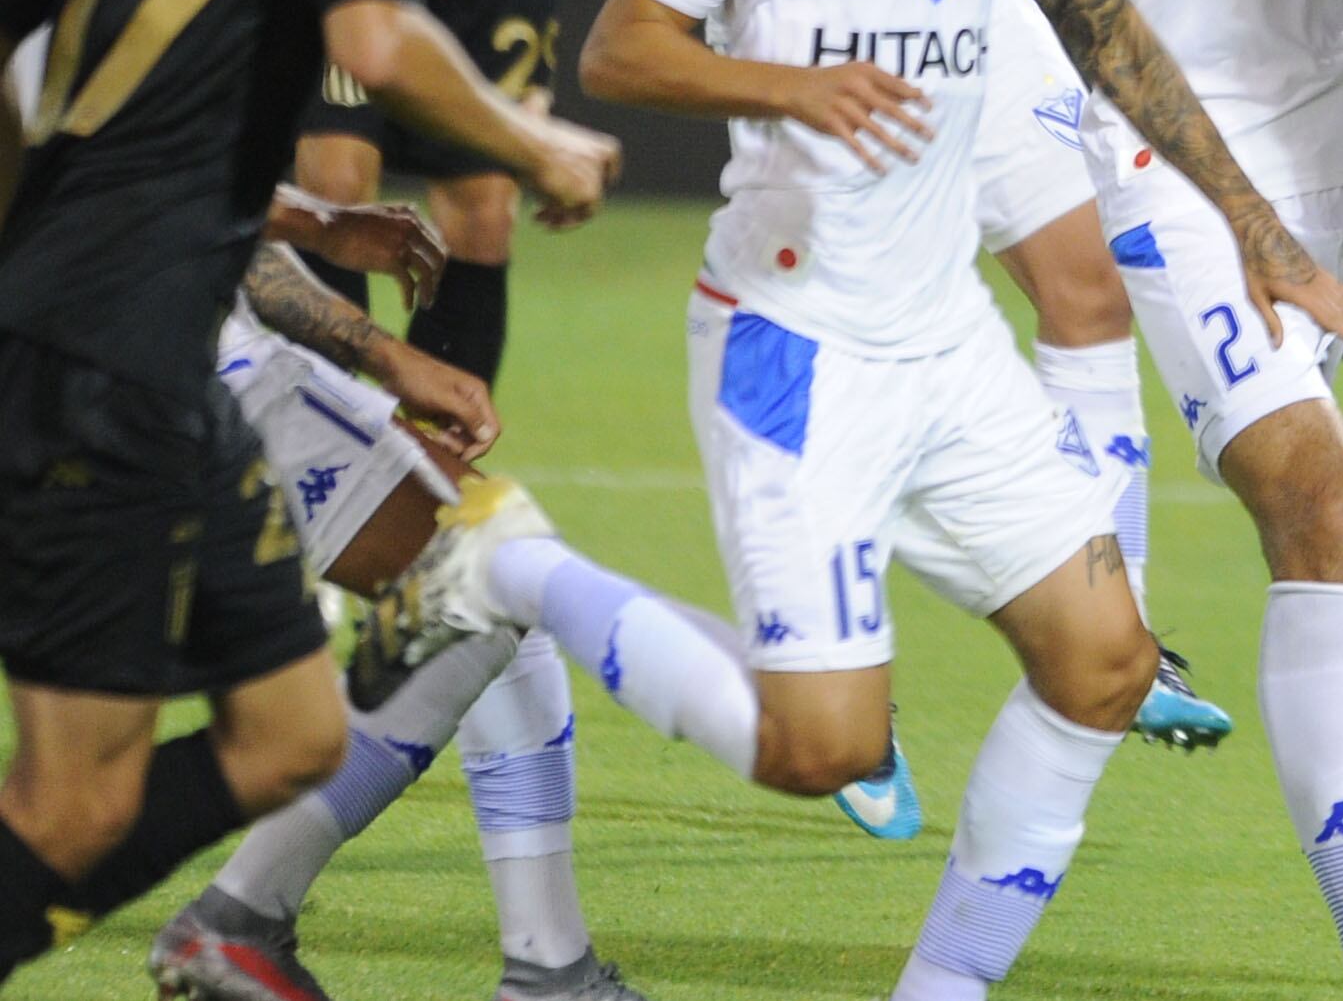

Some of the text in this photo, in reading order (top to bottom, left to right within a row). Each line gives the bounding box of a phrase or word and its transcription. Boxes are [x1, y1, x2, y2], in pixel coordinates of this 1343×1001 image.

[809, 25, 988, 79] HITAC
[1199, 302, 1260, 391] 2
[829, 539, 884, 642] 15
